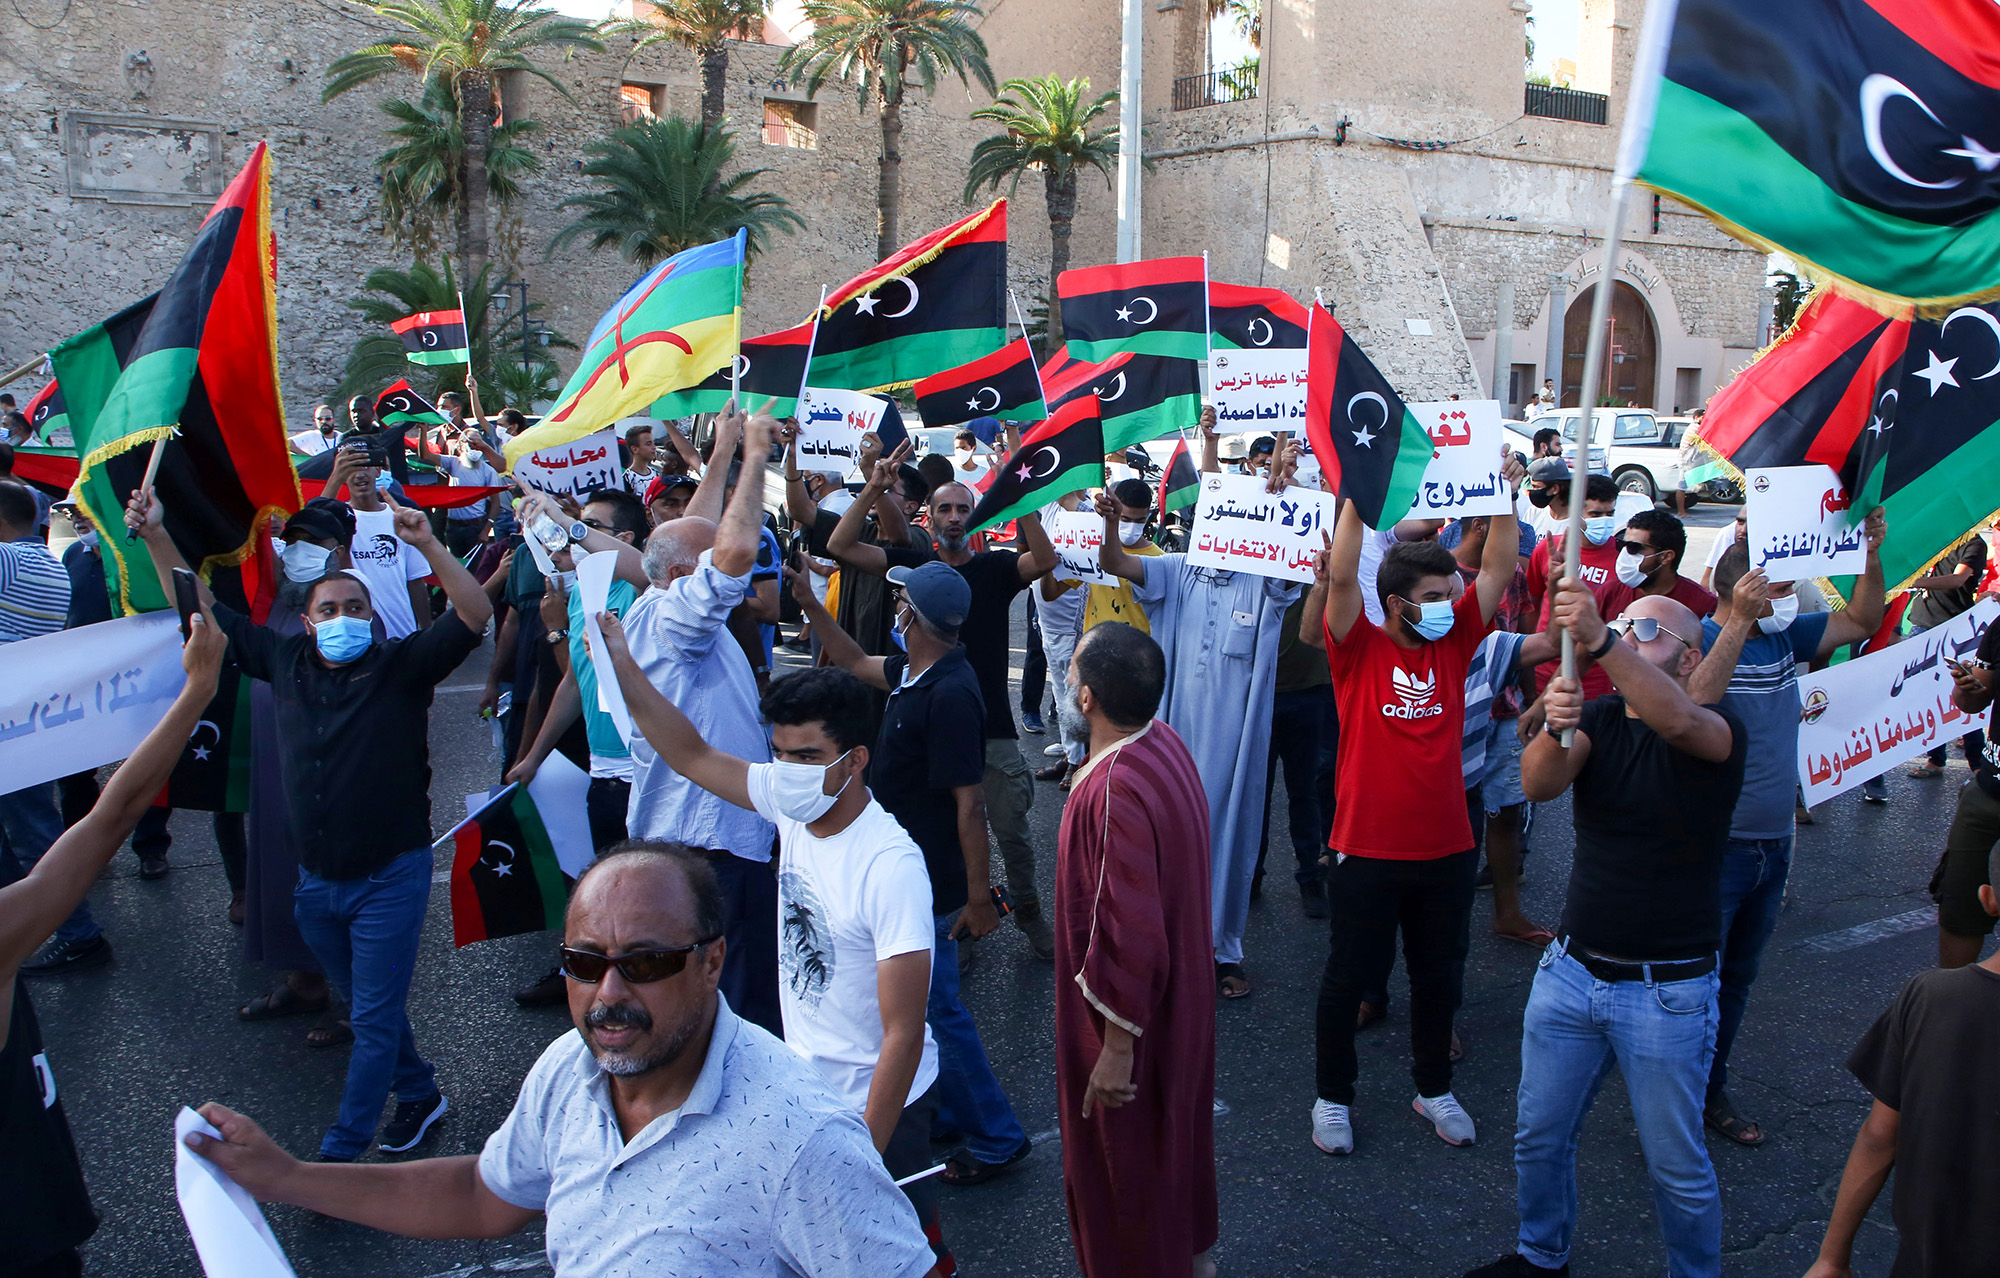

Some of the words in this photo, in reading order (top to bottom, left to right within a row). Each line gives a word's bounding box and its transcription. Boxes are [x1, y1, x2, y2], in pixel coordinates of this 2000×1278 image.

[1215, 372, 1252, 391] تريس
[1255, 372, 1287, 389] عليها
[1291, 369, 1309, 388] توا
[805, 402, 843, 426] حفتر
[1217, 401, 1287, 421] العاصمة
[1290, 399, 1307, 418] ذه
[1424, 471, 1504, 509] السروج
[1203, 499, 1275, 522] الدستور
[1820, 487, 1852, 525] عم
[351, 550, 377, 560] ESAT
[1197, 533, 1287, 562] الانتخابات
[1756, 532, 1821, 567] الفاغنر
[1822, 529, 1862, 560] لطرد
[1577, 562, 1609, 585] MEI
